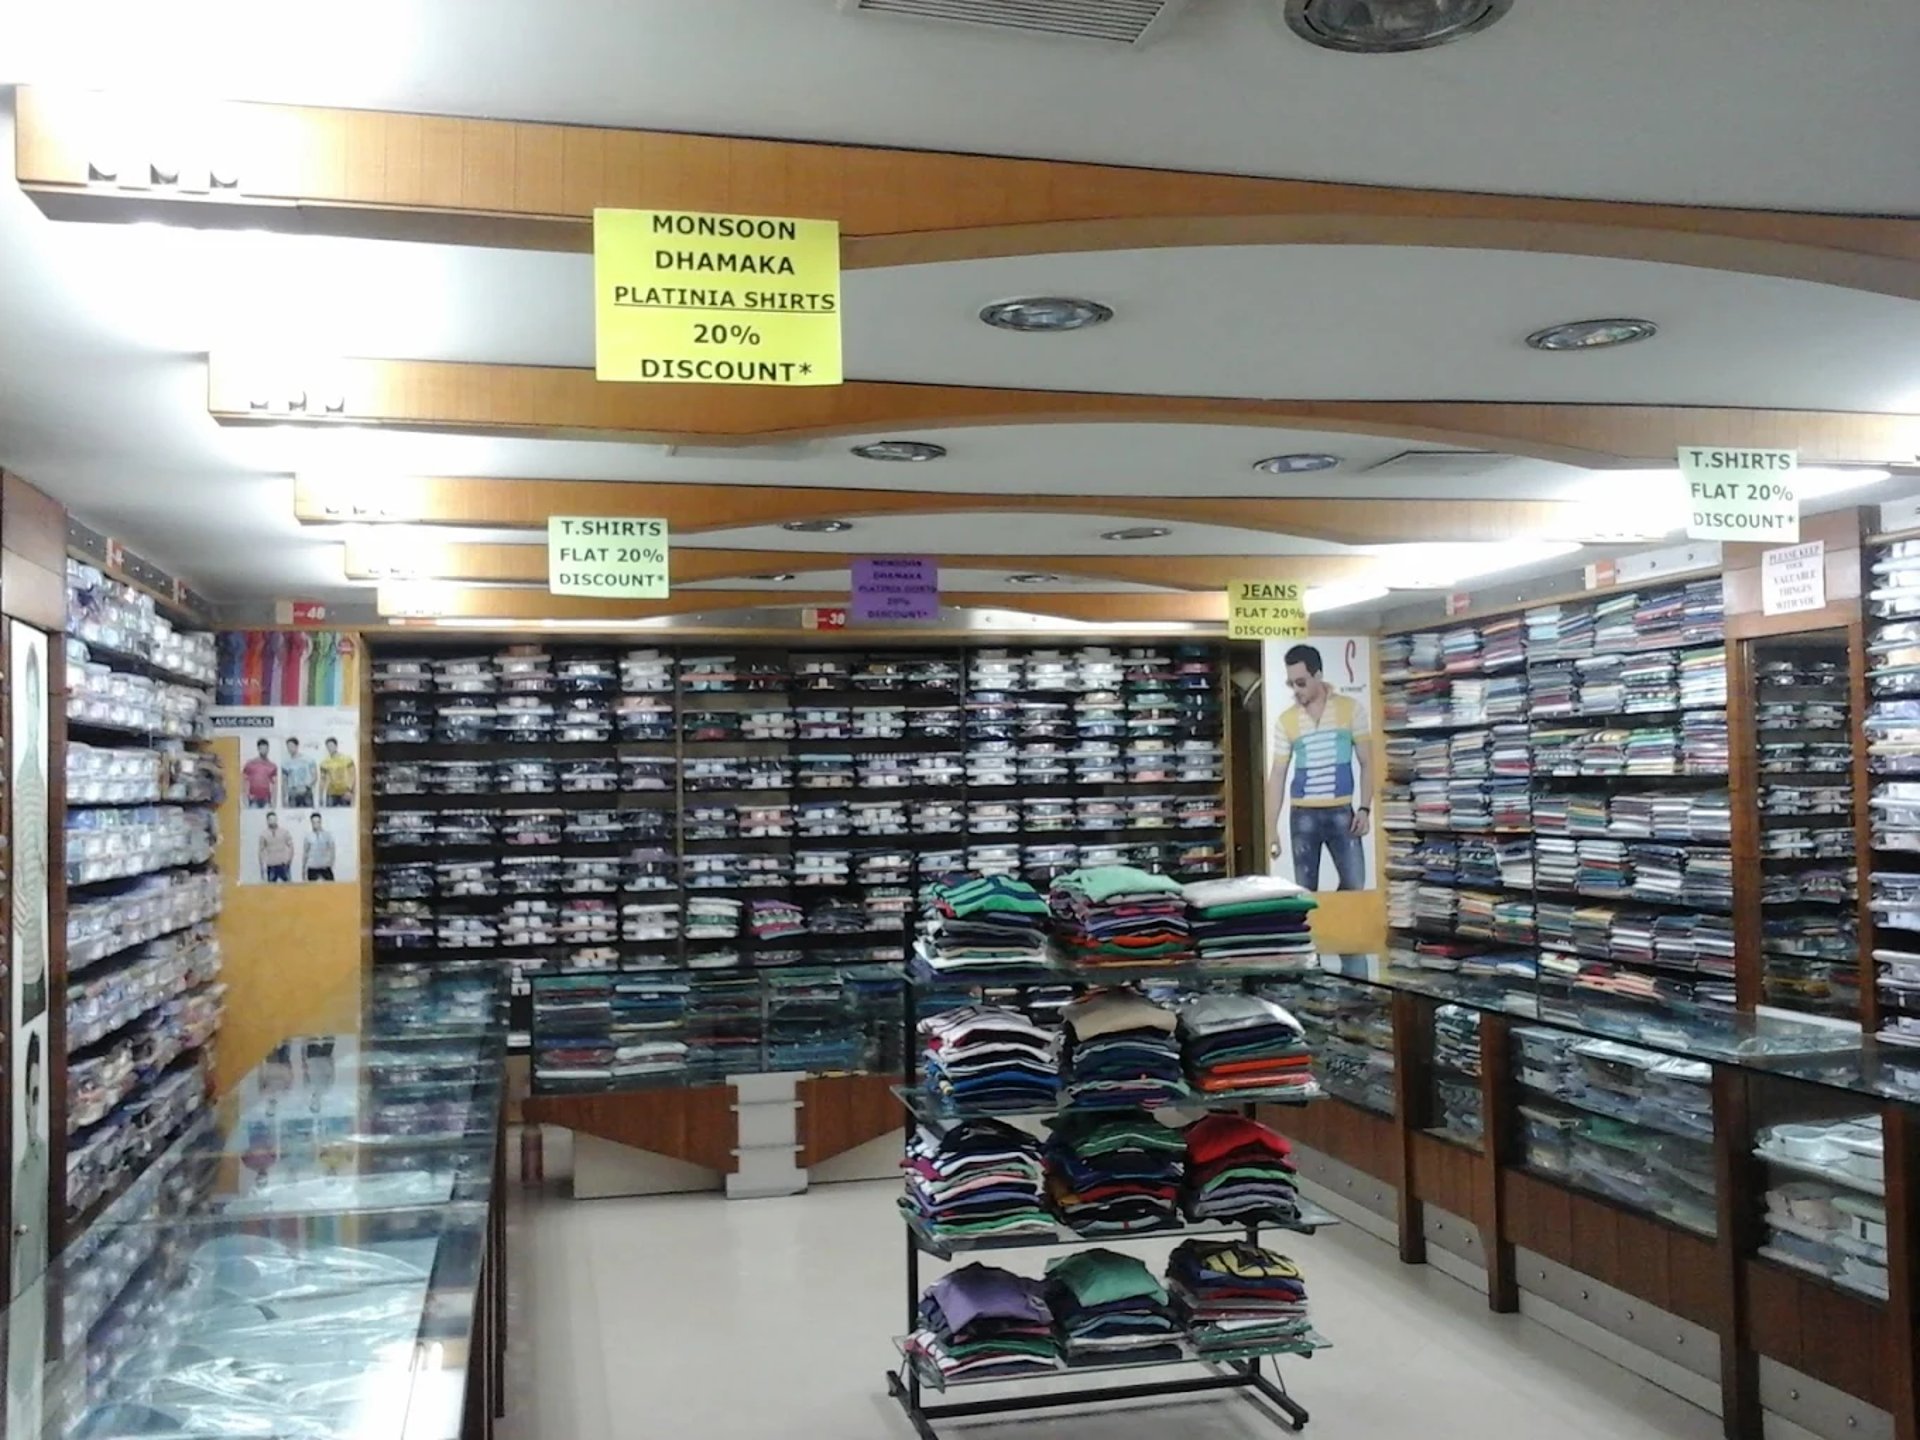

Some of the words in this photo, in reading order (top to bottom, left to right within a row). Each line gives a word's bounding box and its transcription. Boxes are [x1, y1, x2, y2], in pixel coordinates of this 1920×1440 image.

[652, 215, 796, 240] MONSOON
[655, 250, 795, 275] DHAMAKA
[614, 286, 735, 307] PLATINIA
[744, 291, 835, 310] SHIRTS
[693, 324, 761, 345] 20%
[1690, 451, 1791, 470] T.SHIRTS
[1690, 482, 1739, 500] FLAT
[1747, 484, 1794, 501] 20%
[560, 520, 661, 537] T.SHIRTS
[559, 547, 609, 562] FLAT
[617, 548, 664, 563] 20%
[1241, 584, 1297, 598] JEANS
[1235, 607, 1267, 618] FLAT
[1272, 608, 1305, 619] 20%
